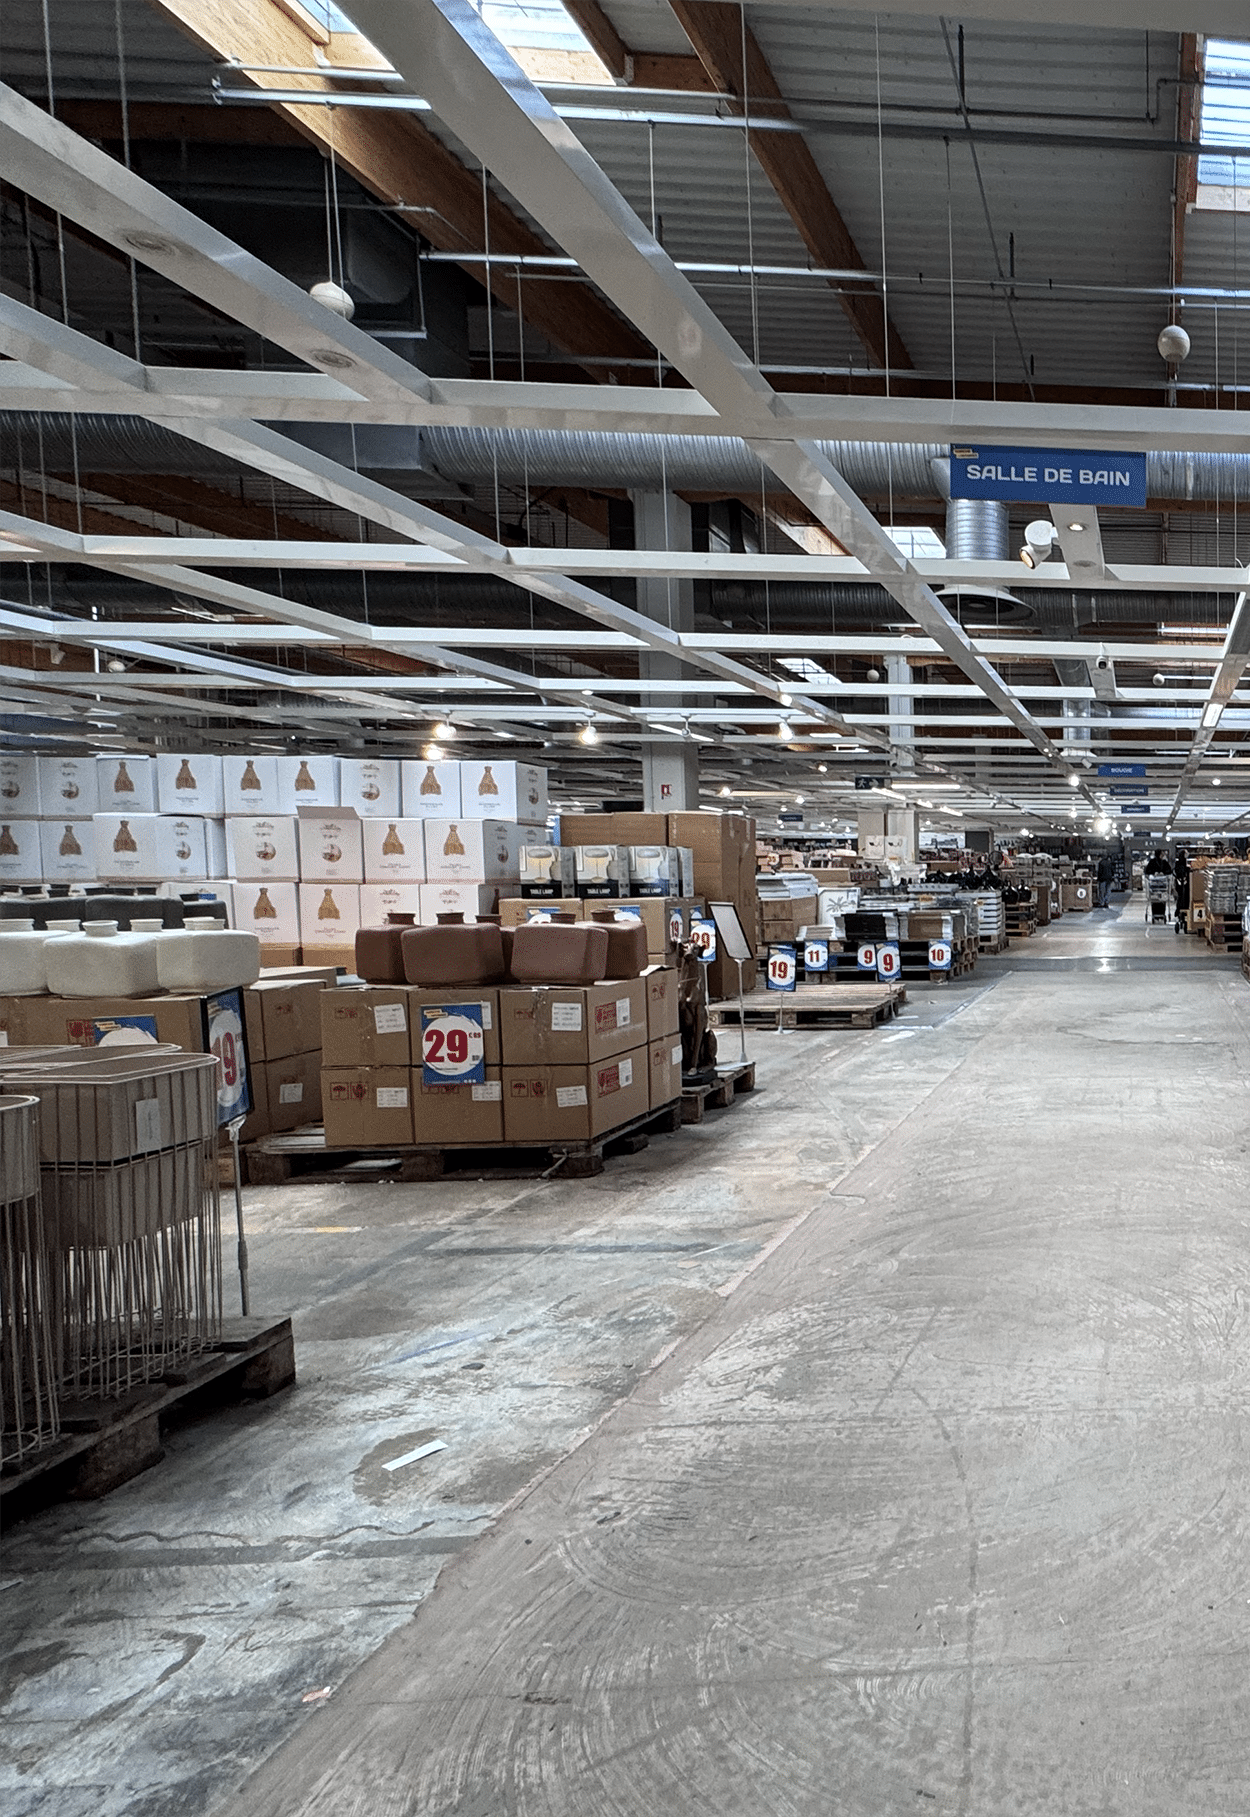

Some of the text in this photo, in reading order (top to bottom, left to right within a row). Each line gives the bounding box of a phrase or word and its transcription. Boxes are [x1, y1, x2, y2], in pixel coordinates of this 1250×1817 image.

[966, 464, 1130, 487] SALLE DE BAIN
[808, 949, 820, 963] 11
[864, 949, 873, 964] 9
[883, 953, 894, 972] 9
[931, 948, 944, 962] 10
[770, 961, 788, 979] 19
[424, 1029, 468, 1063] 29
